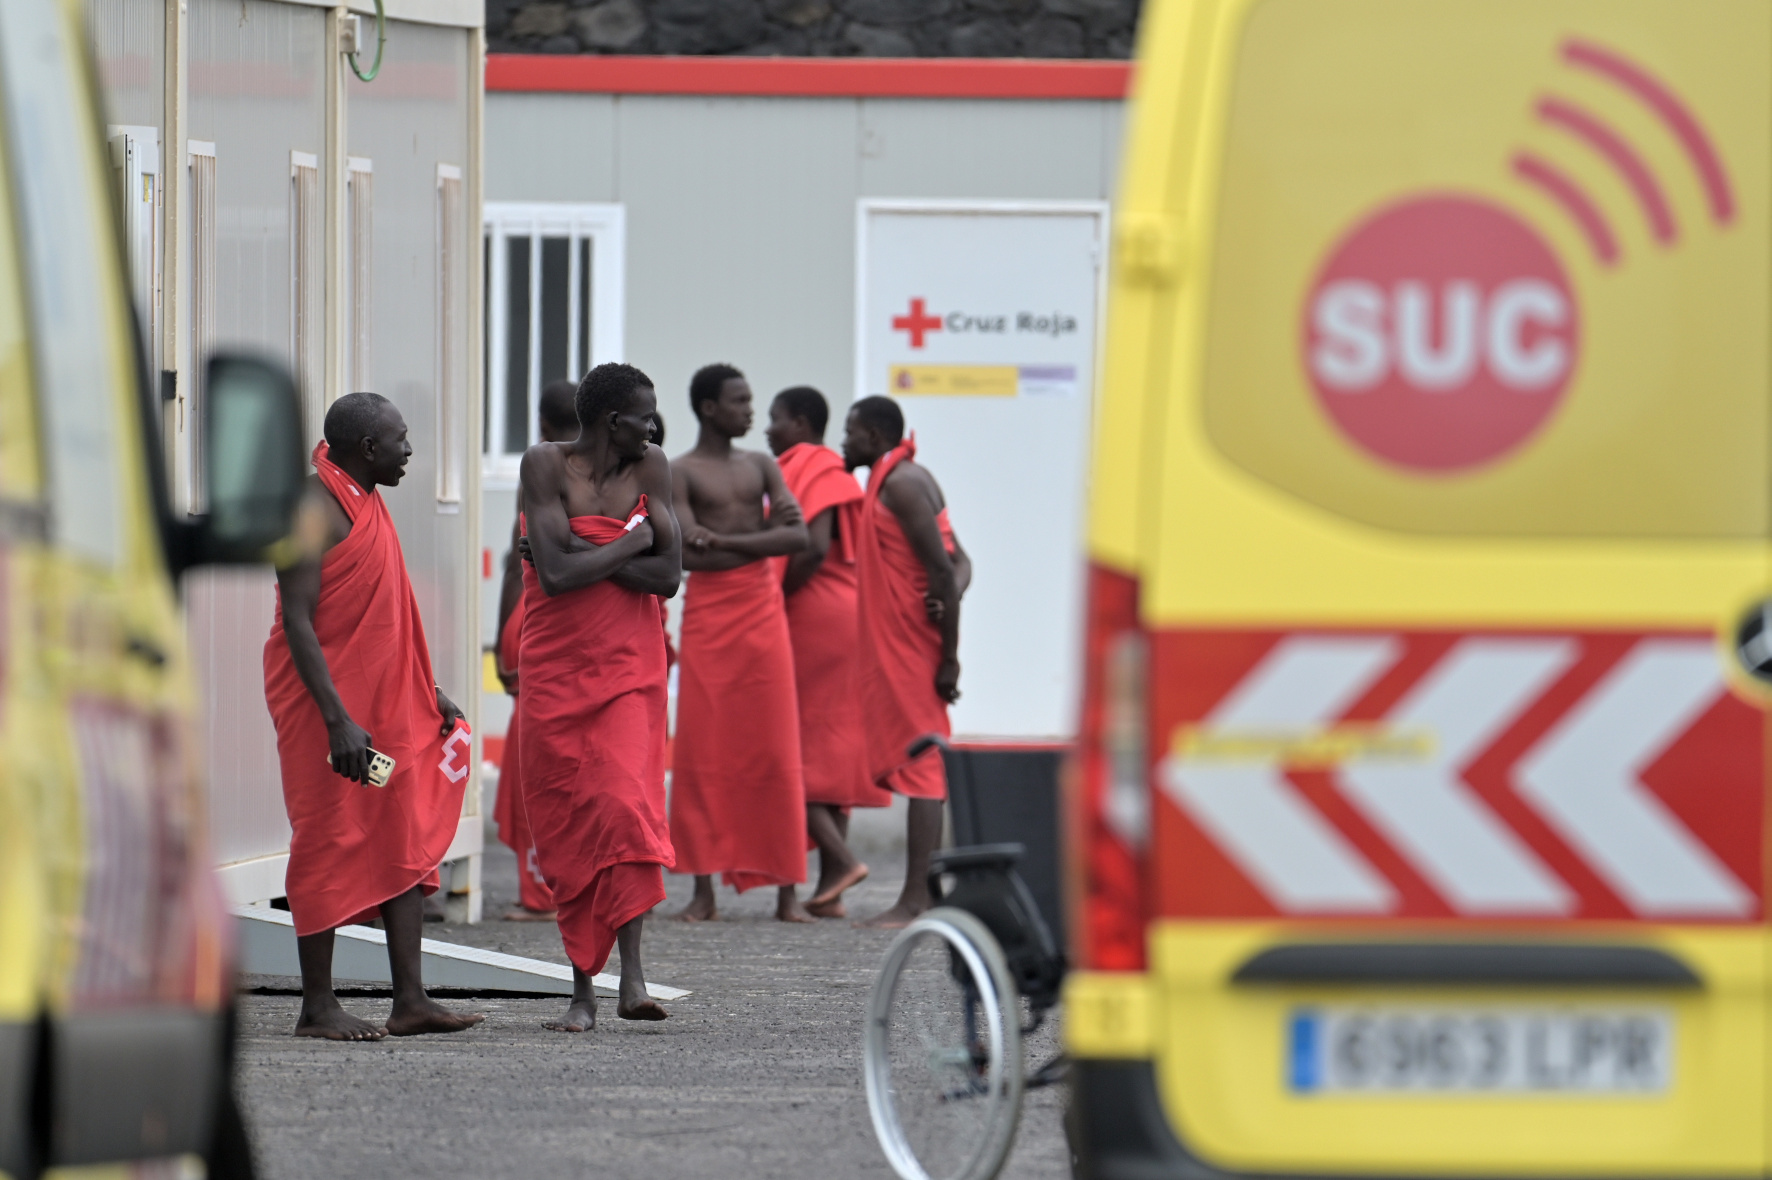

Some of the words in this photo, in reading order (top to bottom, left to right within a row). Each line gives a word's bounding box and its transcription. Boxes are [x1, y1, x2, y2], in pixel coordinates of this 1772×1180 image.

[945, 311, 1007, 334] Cruz
[1016, 311, 1078, 338] Roja
[1312, 278, 1570, 390] SUC
[1527, 1015, 1663, 1088] LPR
